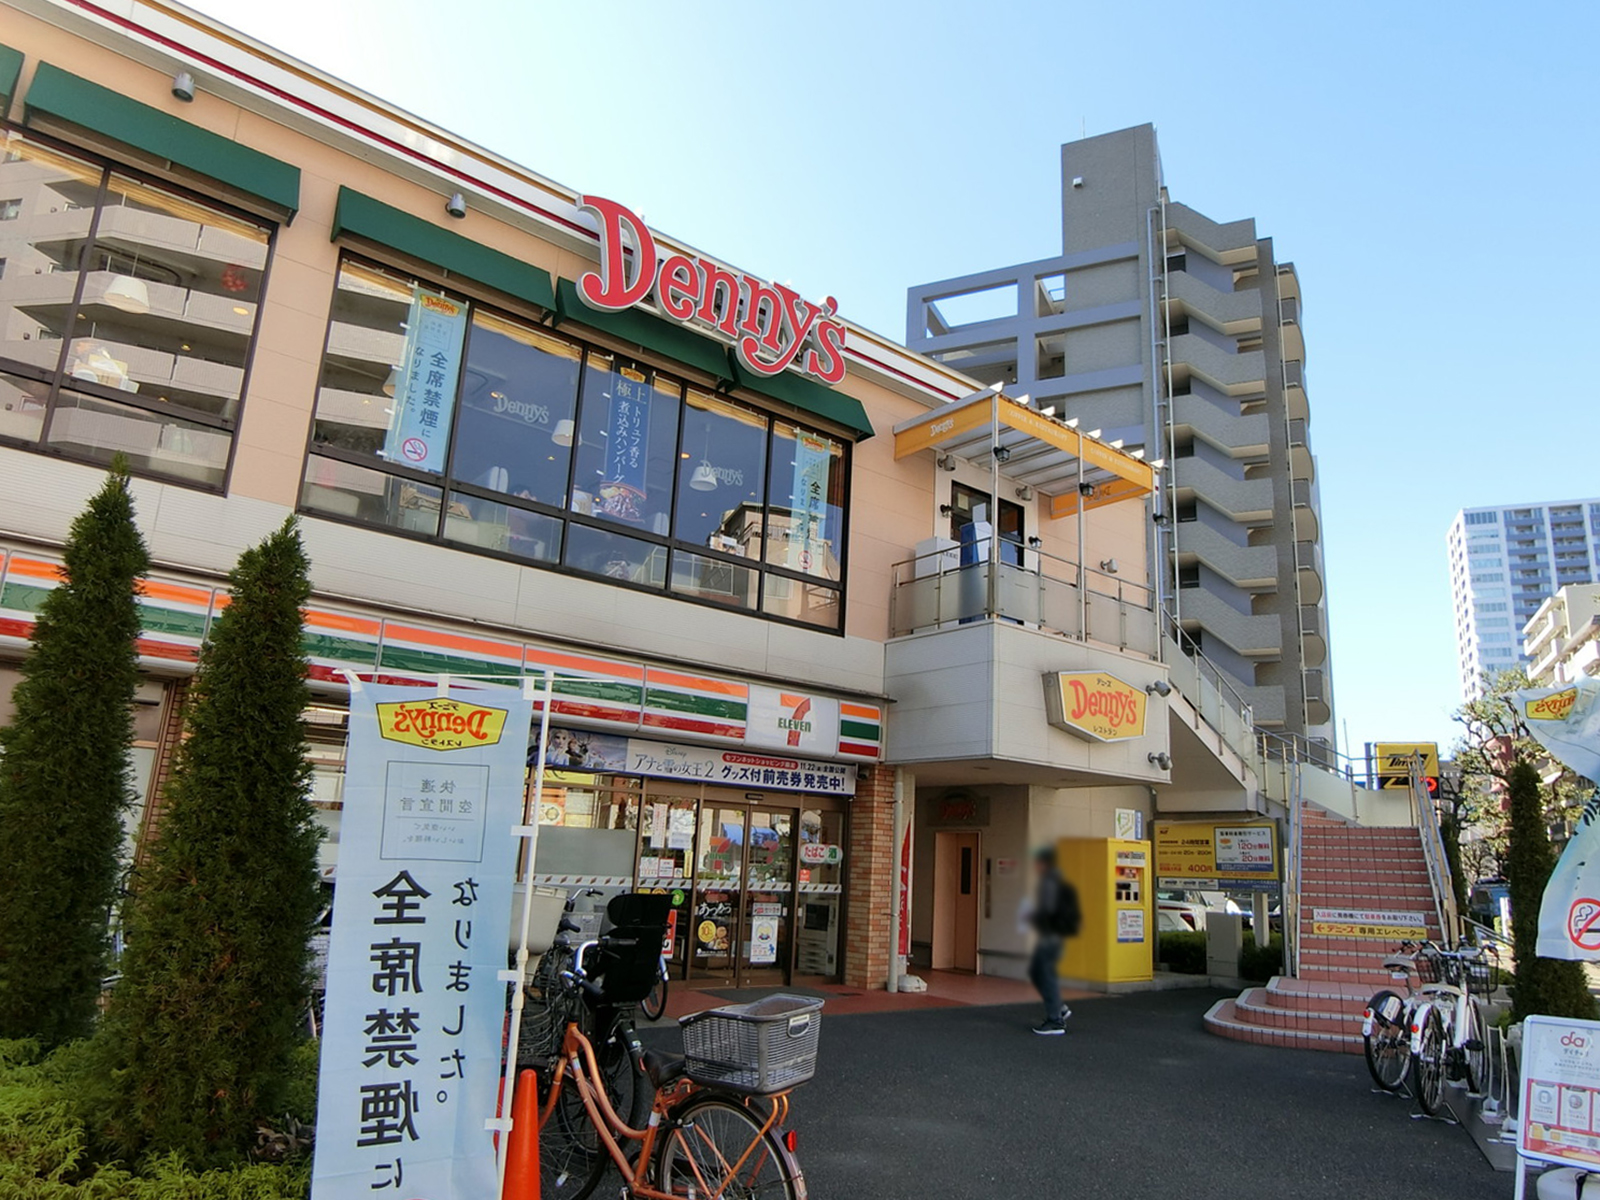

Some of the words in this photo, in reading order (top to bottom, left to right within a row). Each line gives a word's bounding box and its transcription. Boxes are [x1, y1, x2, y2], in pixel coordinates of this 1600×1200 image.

[576, 194, 846, 384] Denny's
[418, 351, 449, 439] 全席禁煙に
[492, 394, 549, 424] Denny's
[1068, 679, 1137, 728] Denny's
[633, 753, 715, 779] アナと雪の女王2
[804, 846, 825, 859] たばこ
[1327, 925, 1357, 934] デニーズ
[1359, 927, 1425, 937] 専用エレベーター
